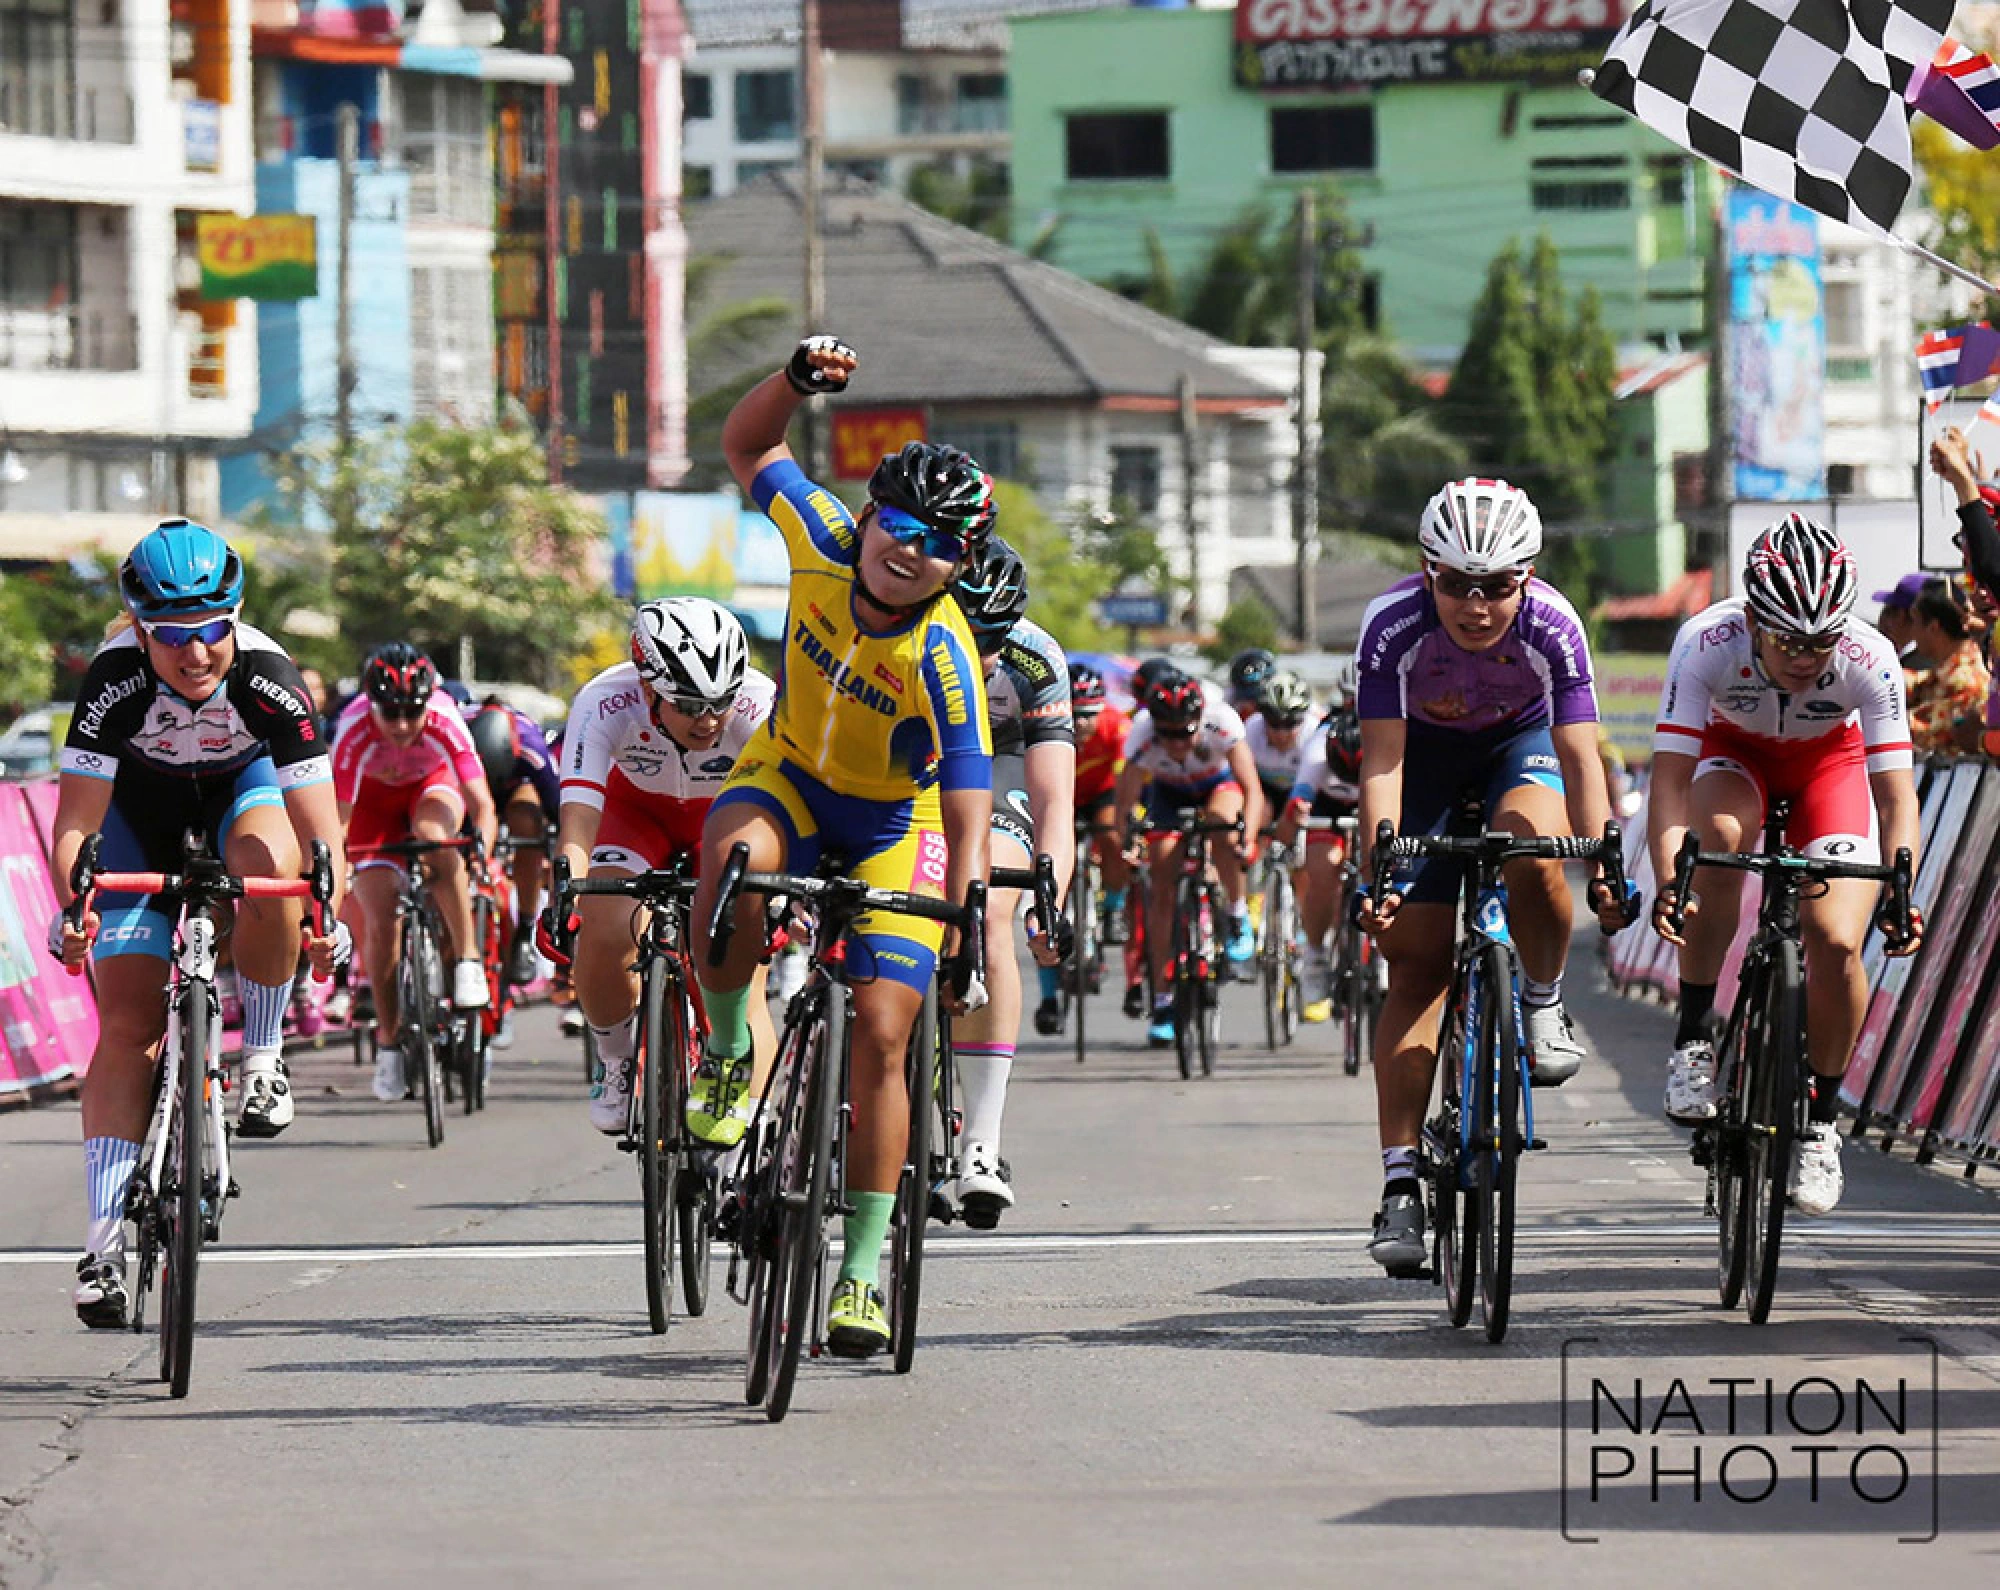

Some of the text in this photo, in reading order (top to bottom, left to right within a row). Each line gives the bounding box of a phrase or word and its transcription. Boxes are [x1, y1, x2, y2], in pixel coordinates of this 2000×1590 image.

[249, 675, 307, 718] ENERGY
[793, 618, 898, 717] THAILAND
[931, 640, 969, 726] THAILAND
